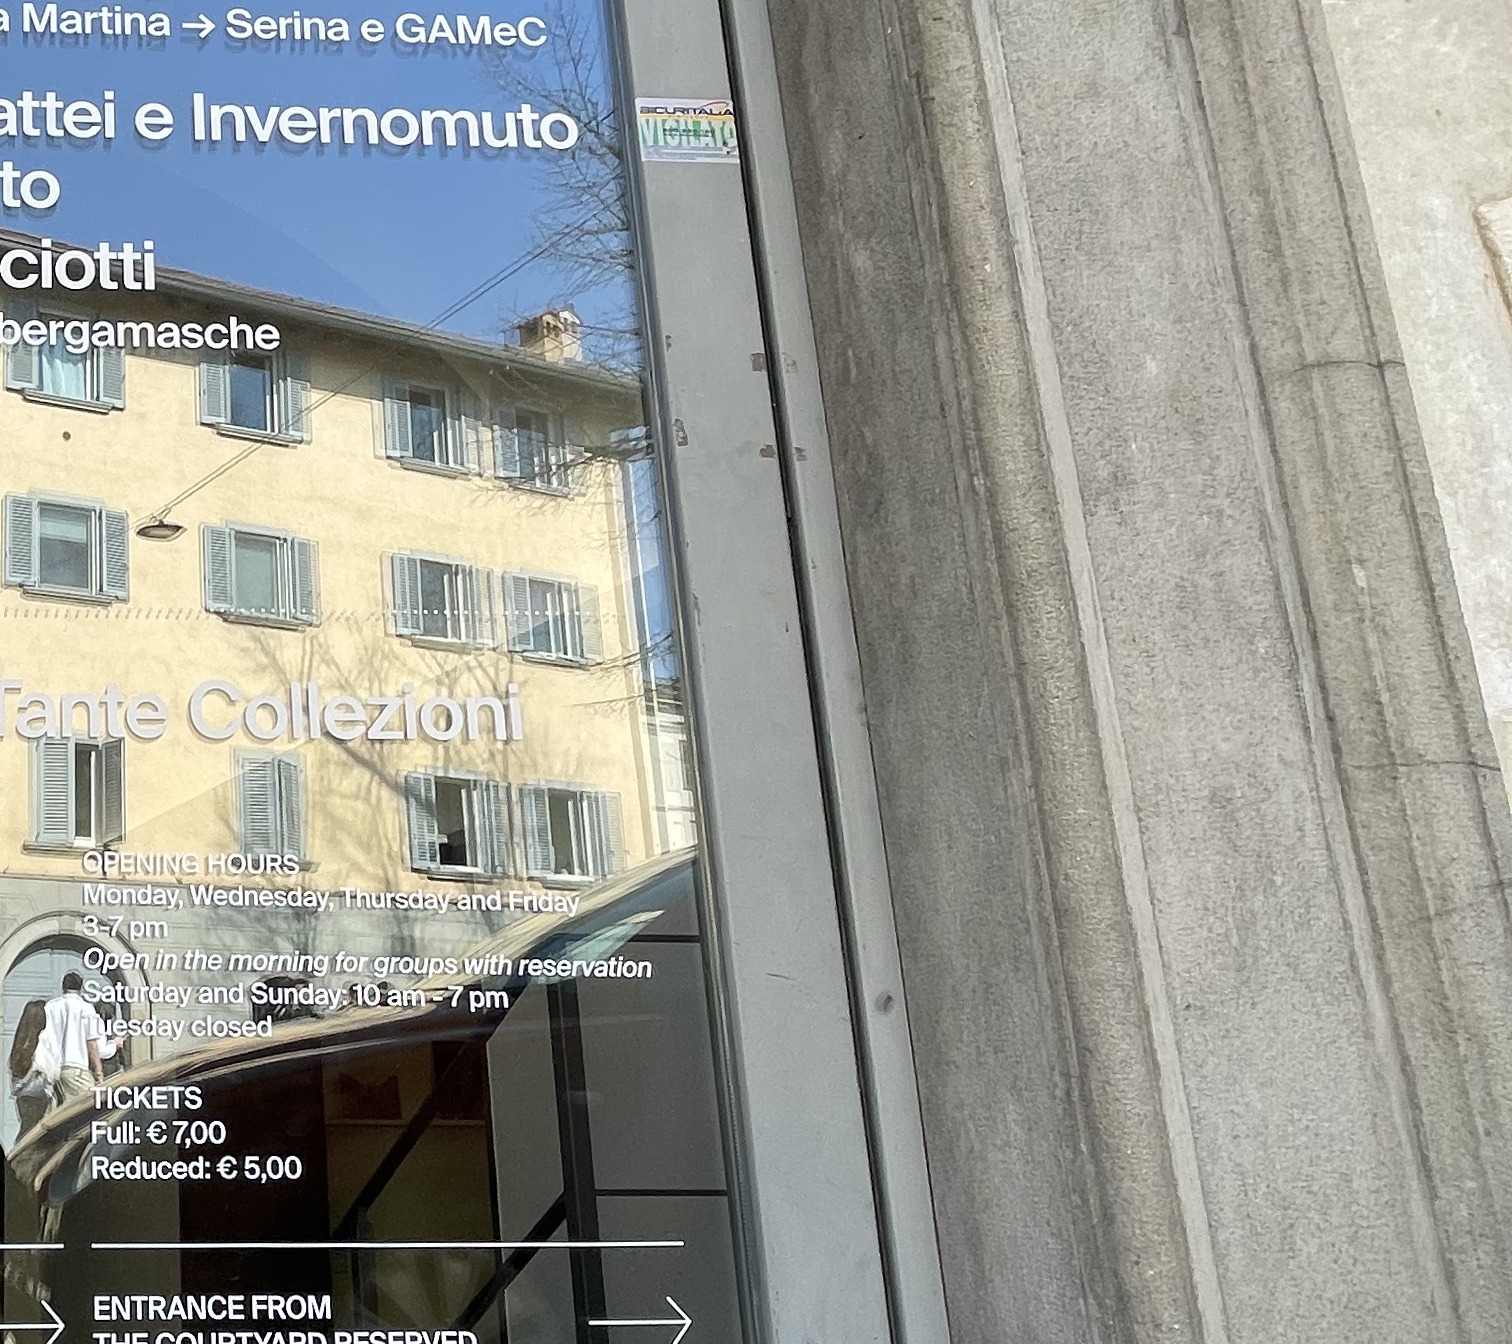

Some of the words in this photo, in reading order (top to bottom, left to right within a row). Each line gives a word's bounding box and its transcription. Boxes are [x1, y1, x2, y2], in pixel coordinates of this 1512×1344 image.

[23, 2, 171, 38] Martina
[226, 8, 349, 42] Serina
[361, 19, 385, 42] e
[396, 12, 547, 47] GAMeC
[135, 102, 174, 140] e
[193, 92, 579, 149] Invernomuto
[189, 679, 523, 742] Collezioni
[83, 850, 199, 874] OPENING
[208, 854, 299, 875] HOURS
[84, 884, 183, 909] Monday,
[190, 885, 334, 912] Wednesday,
[340, 887, 449, 914] Thursday
[457, 890, 501, 910] and
[508, 890, 580, 917] Friday
[82, 915, 124, 937] 3-7
[130, 920, 168, 941] pm
[84, 948, 148, 973] Open
[156, 949, 177, 969] in
[184, 949, 222, 970] the
[228, 950, 328, 975] morning
[335, 951, 366, 972] for
[374, 957, 458, 978] groups
[464, 954, 512, 976] with
[518, 955, 652, 978] reservation
[84, 981, 190, 1006] Saturday
[198, 983, 243, 1004] and
[251, 984, 347, 1006] Sunday:
[353, 984, 380, 1004] 10
[387, 989, 425, 1006] am
[448, 987, 464, 1008] 7
[469, 989, 509, 1012] pm
[190, 1015, 273, 1038] closed
[90, 1086, 203, 1110] TICKETS
[91, 1121, 142, 1146] Full:
[146, 1122, 168, 1145] €
[172, 1121, 227, 1149] 7,00
[91, 1156, 211, 1181] Reduced:
[216, 1157, 238, 1181] €
[244, 1156, 303, 1183] 5,00
[93, 1295, 245, 1321] ENTRANCE
[252, 1295, 332, 1321] FROM
